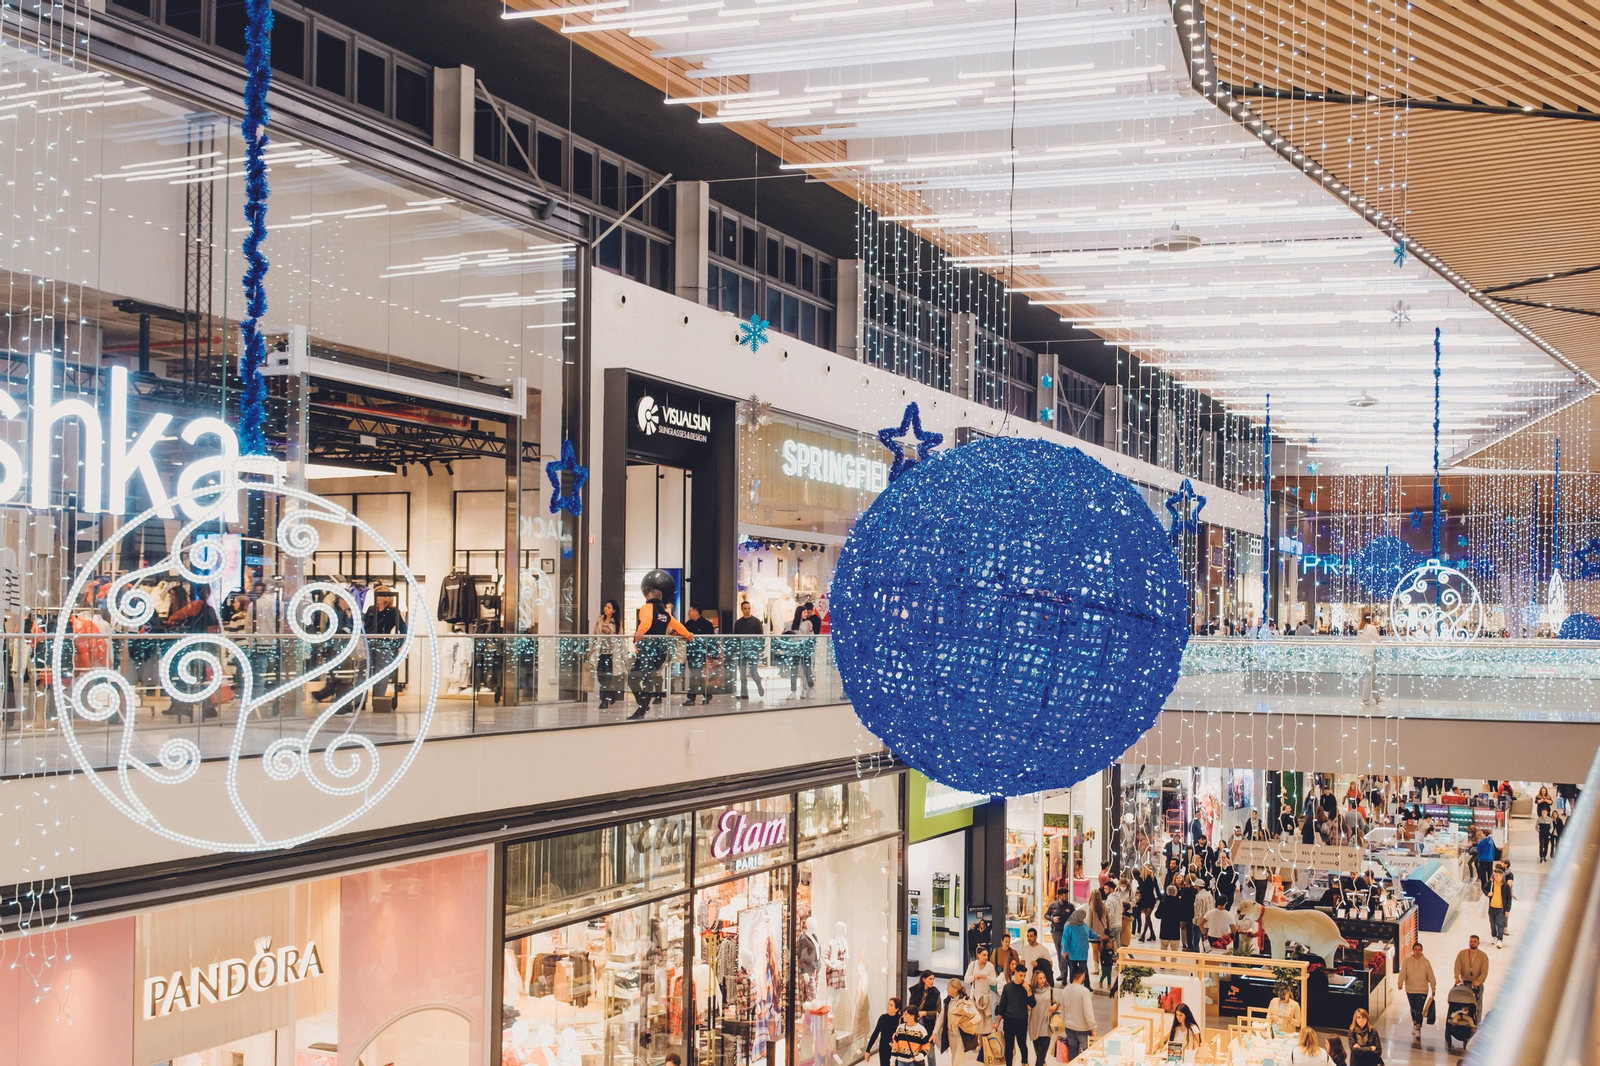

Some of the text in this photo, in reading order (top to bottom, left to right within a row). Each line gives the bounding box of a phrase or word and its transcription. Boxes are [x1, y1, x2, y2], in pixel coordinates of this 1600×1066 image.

[661, 405, 711, 433] VISUALSUN
[781, 439, 887, 493] SPRINGFIEL
[711, 809, 786, 859] Etam
[734, 854, 763, 871] PARIS
[143, 939, 324, 1021] PANDORA
